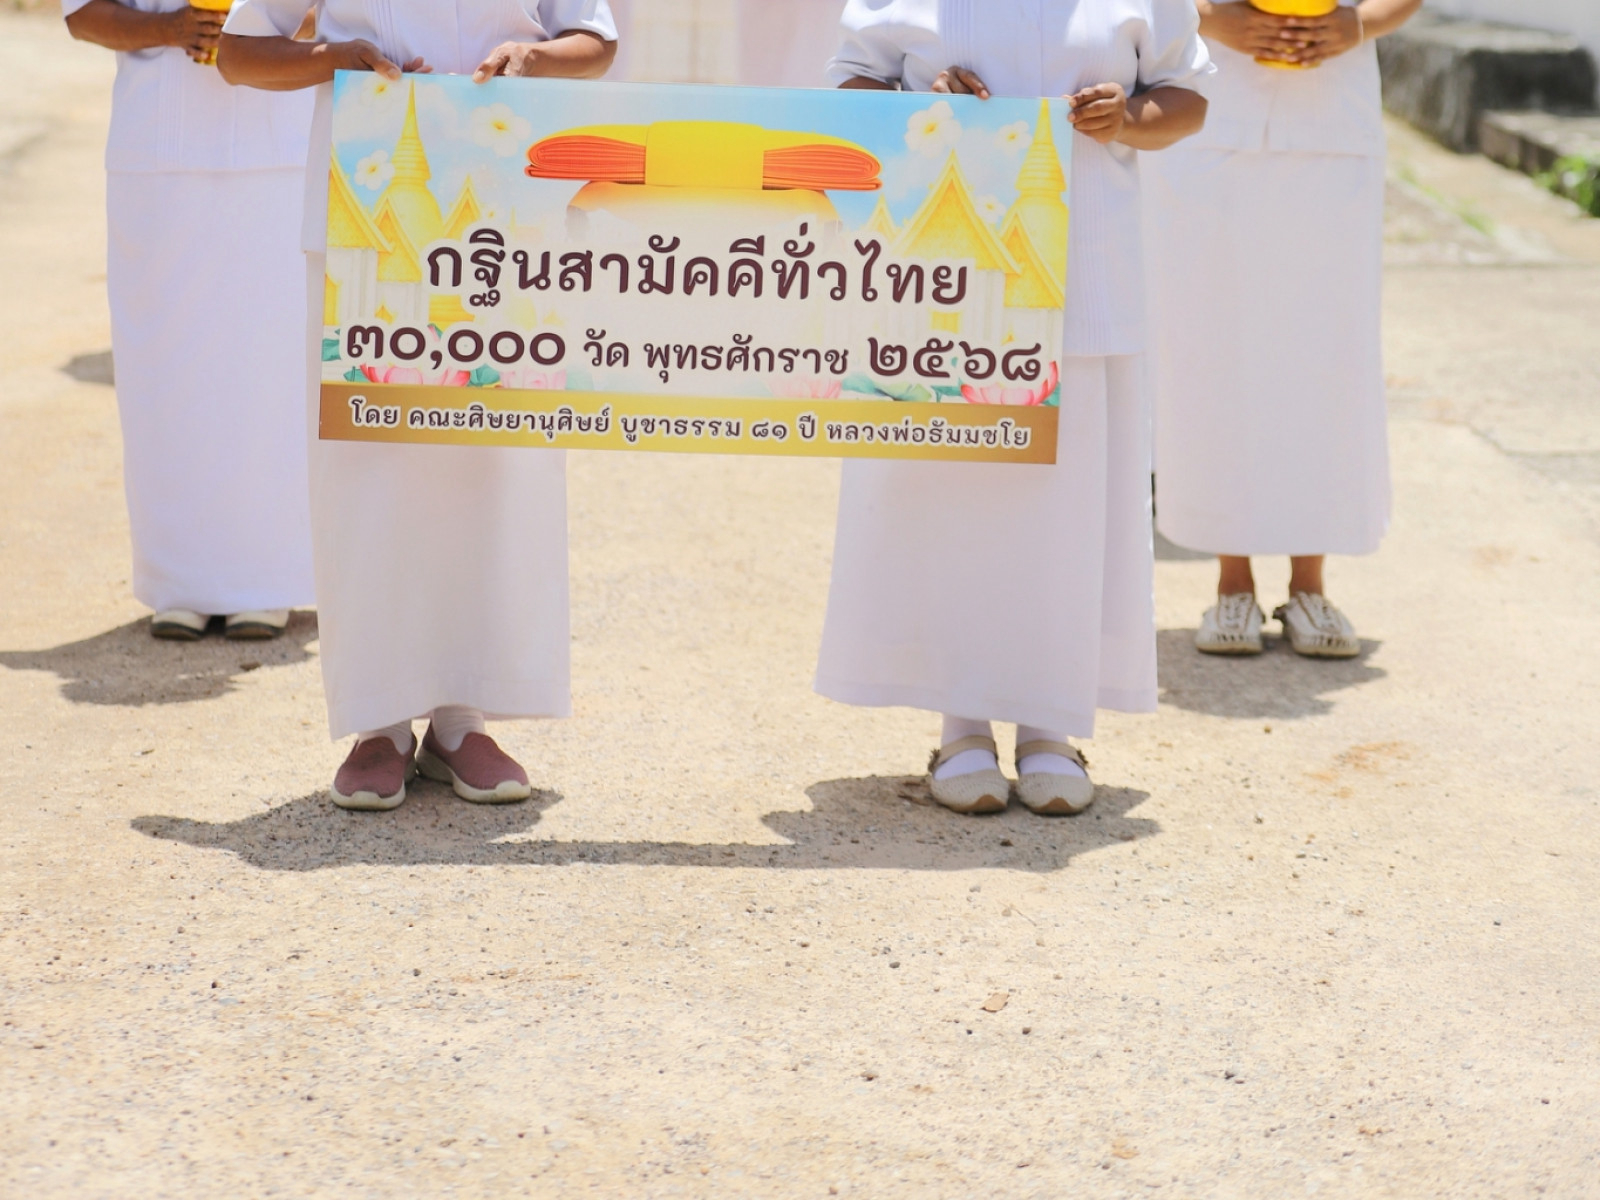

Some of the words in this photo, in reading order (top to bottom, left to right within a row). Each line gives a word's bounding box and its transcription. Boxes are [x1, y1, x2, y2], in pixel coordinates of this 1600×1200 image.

[427, 221, 968, 308] กฐินสามัคคีทั่วไทย
[346, 324, 567, 371] ๓๐,๐๐๐
[583, 327, 630, 368] วัด
[643, 333, 850, 384] พุทธศักราช
[867, 336, 1043, 382] ๒๕๖๘
[351, 398, 399, 426] โดย
[408, 404, 610, 440] คณะศิษยานุศิษย์
[620, 415, 741, 443] บูชาธรรม
[751, 420, 788, 440] ๘๑
[798, 414, 816, 440] ปี
[826, 417, 1029, 446] หลวงพ่อธัมมชโย
